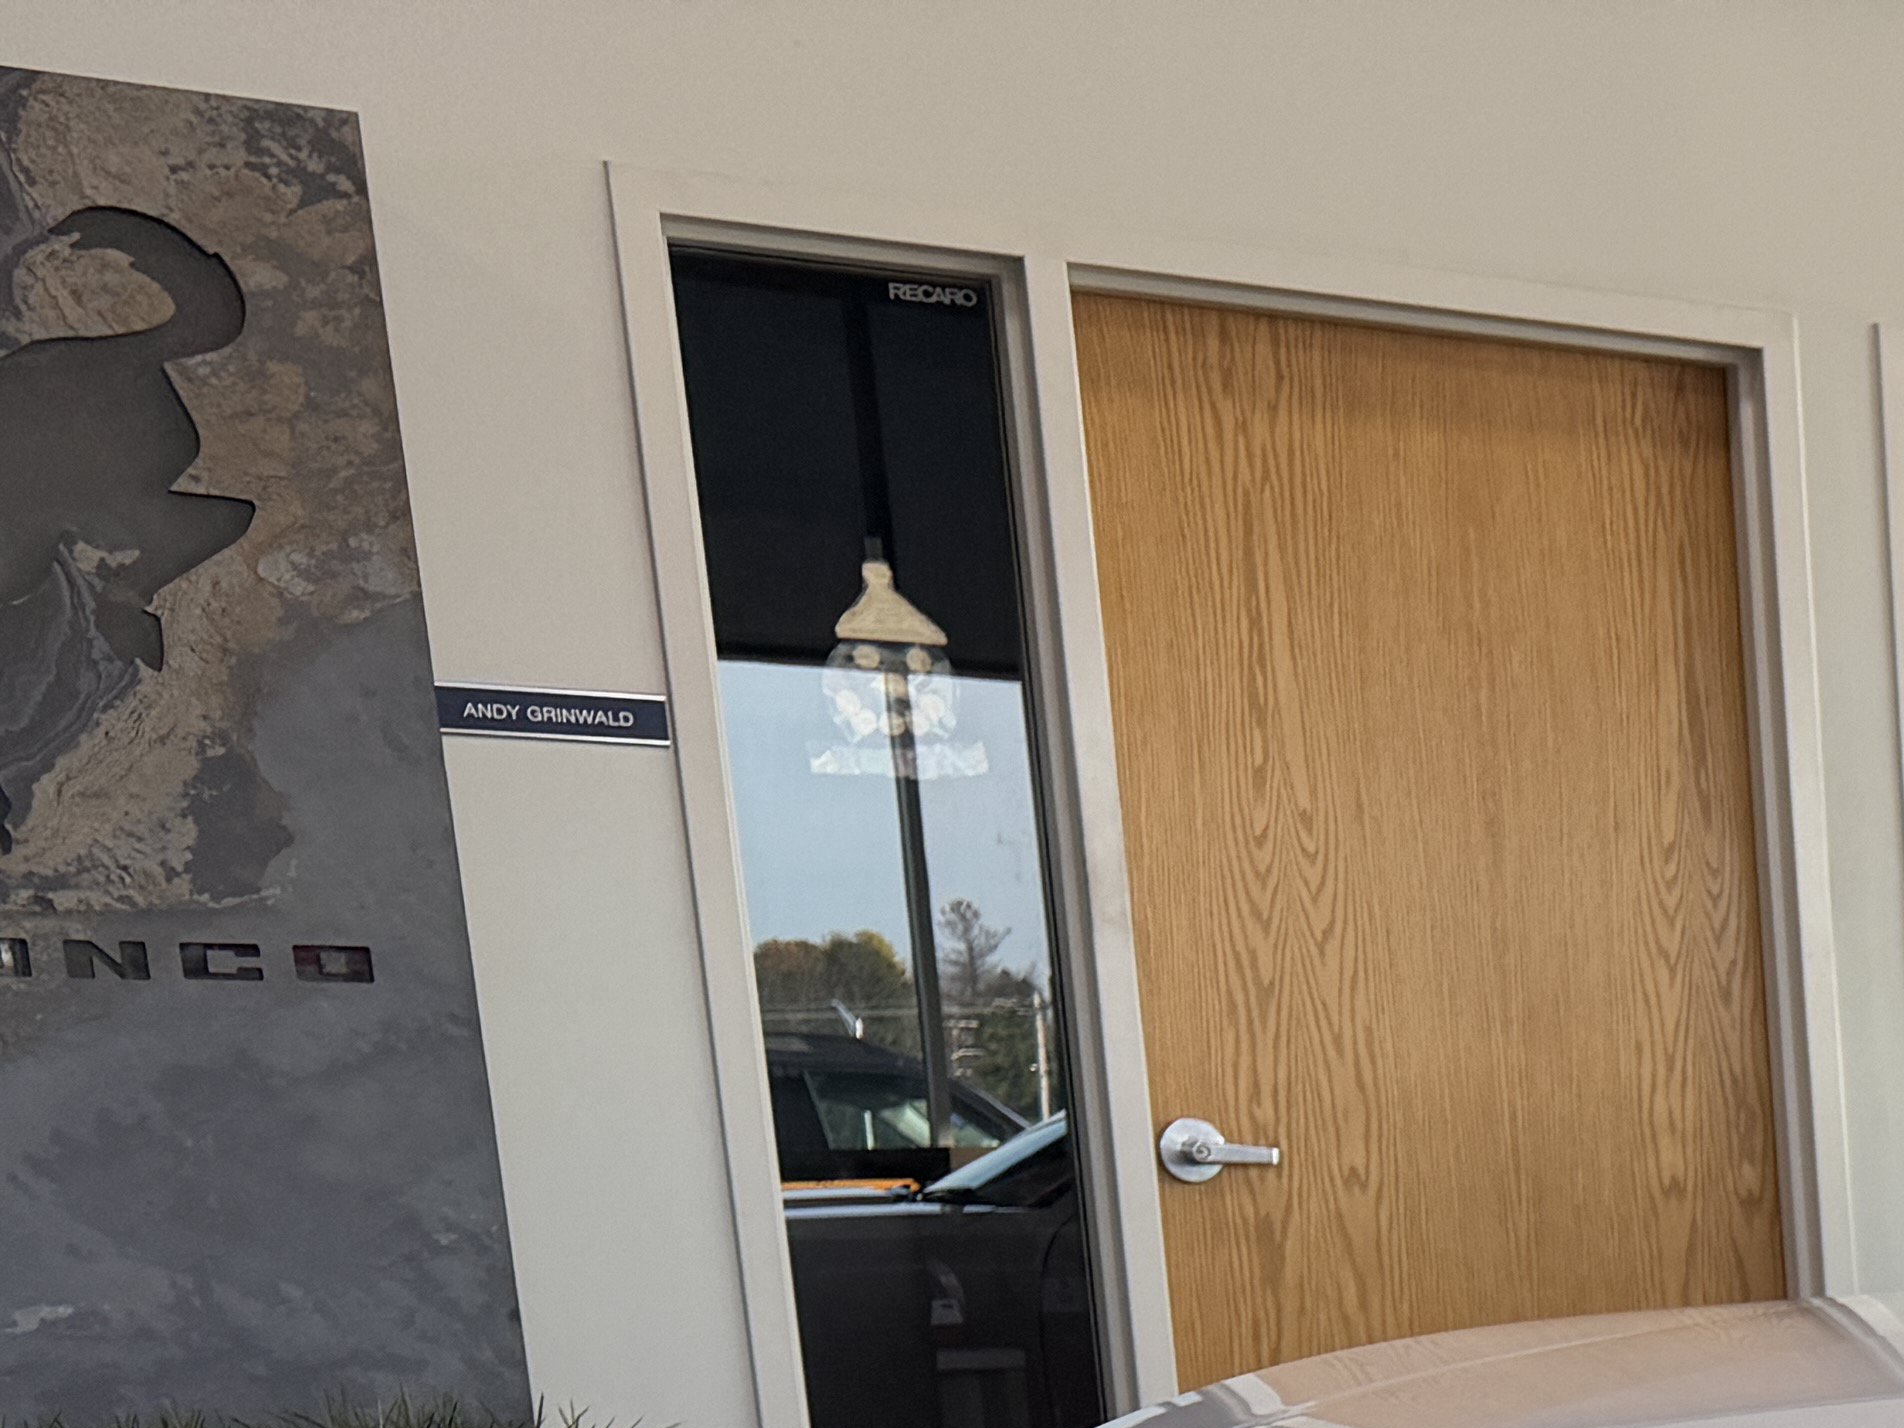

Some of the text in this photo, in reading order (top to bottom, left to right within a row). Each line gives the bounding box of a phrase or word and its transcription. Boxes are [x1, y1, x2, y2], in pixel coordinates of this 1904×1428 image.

[888, 281, 978, 307] RECARO
[464, 702, 634, 728] ANDY GRINWALD
